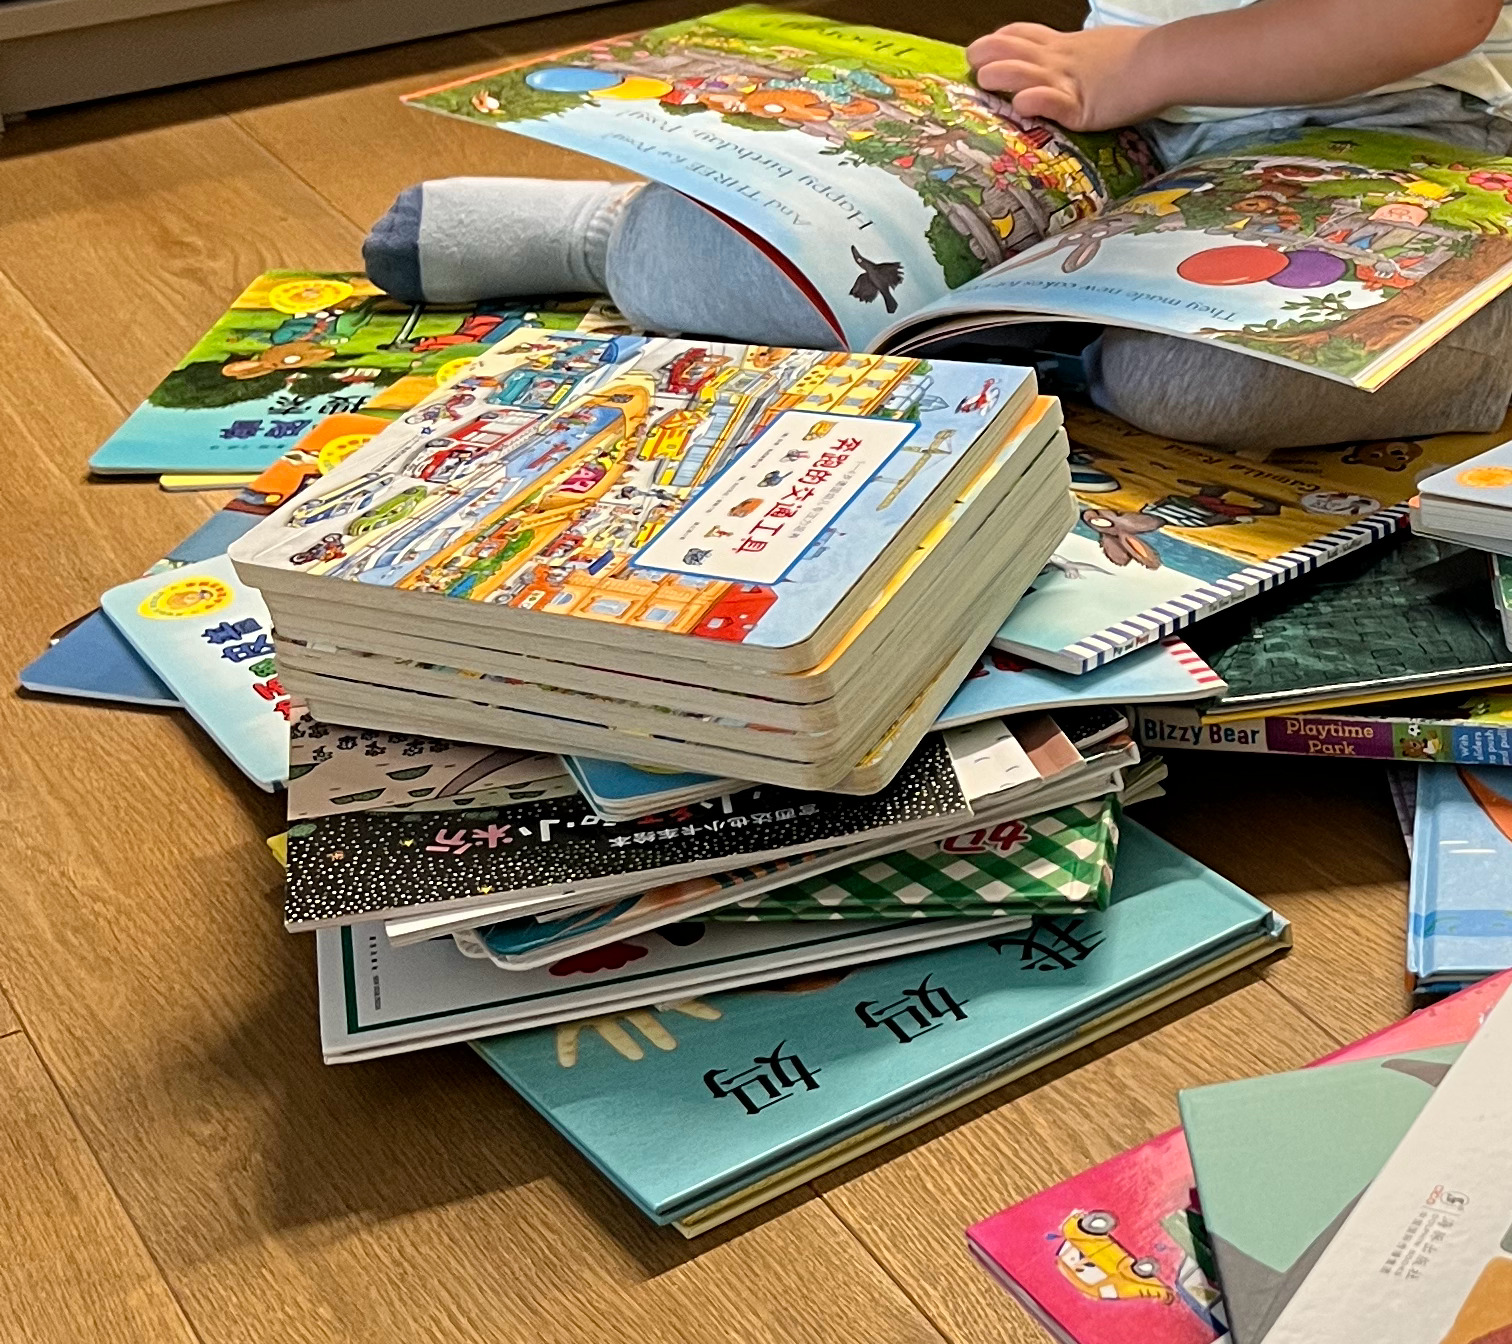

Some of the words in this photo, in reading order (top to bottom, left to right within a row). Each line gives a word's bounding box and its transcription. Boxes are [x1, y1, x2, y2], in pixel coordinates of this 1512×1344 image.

[686, 162, 760, 201] THREE
[763, 199, 811, 227] And
[798, 174, 874, 231] Happy
[1125, 290, 1181, 307] made
[1186, 303, 1237, 323] They
[734, 438, 864, 553] 奔跑的交通工具
[1144, 718, 1203, 746] Bizzy
[1209, 723, 1260, 746] Bear
[1285, 719, 1375, 739] Playtime
[1307, 739, 1356, 756] Park
[703, 918, 1107, 1115] 我妈妈
